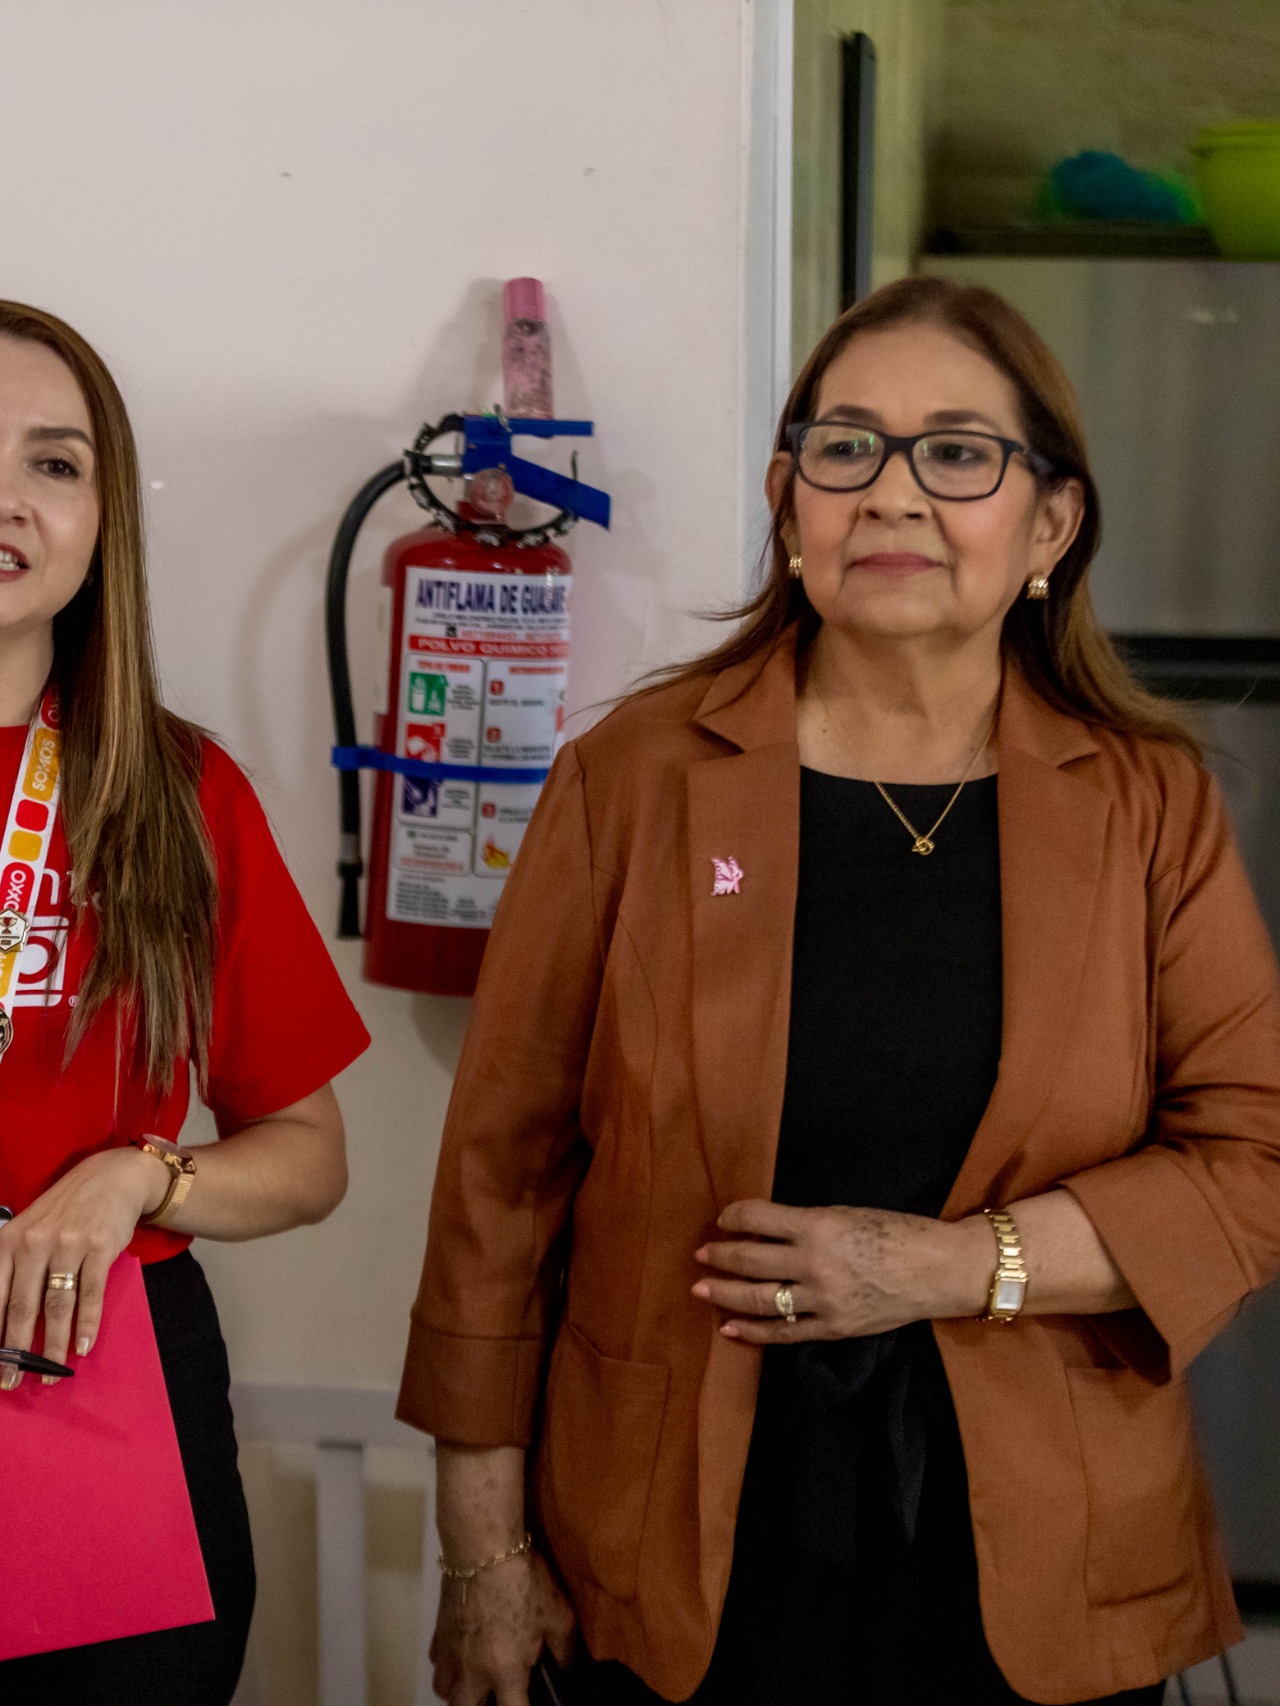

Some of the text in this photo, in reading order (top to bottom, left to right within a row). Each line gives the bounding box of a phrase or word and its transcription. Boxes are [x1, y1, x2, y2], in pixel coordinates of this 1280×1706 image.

[416, 578, 495, 613] ANTIFLAMA
[500, 584, 519, 614] DE
[417, 638, 477, 653] POLVO
[32, 739, 55, 792] SOMOS
